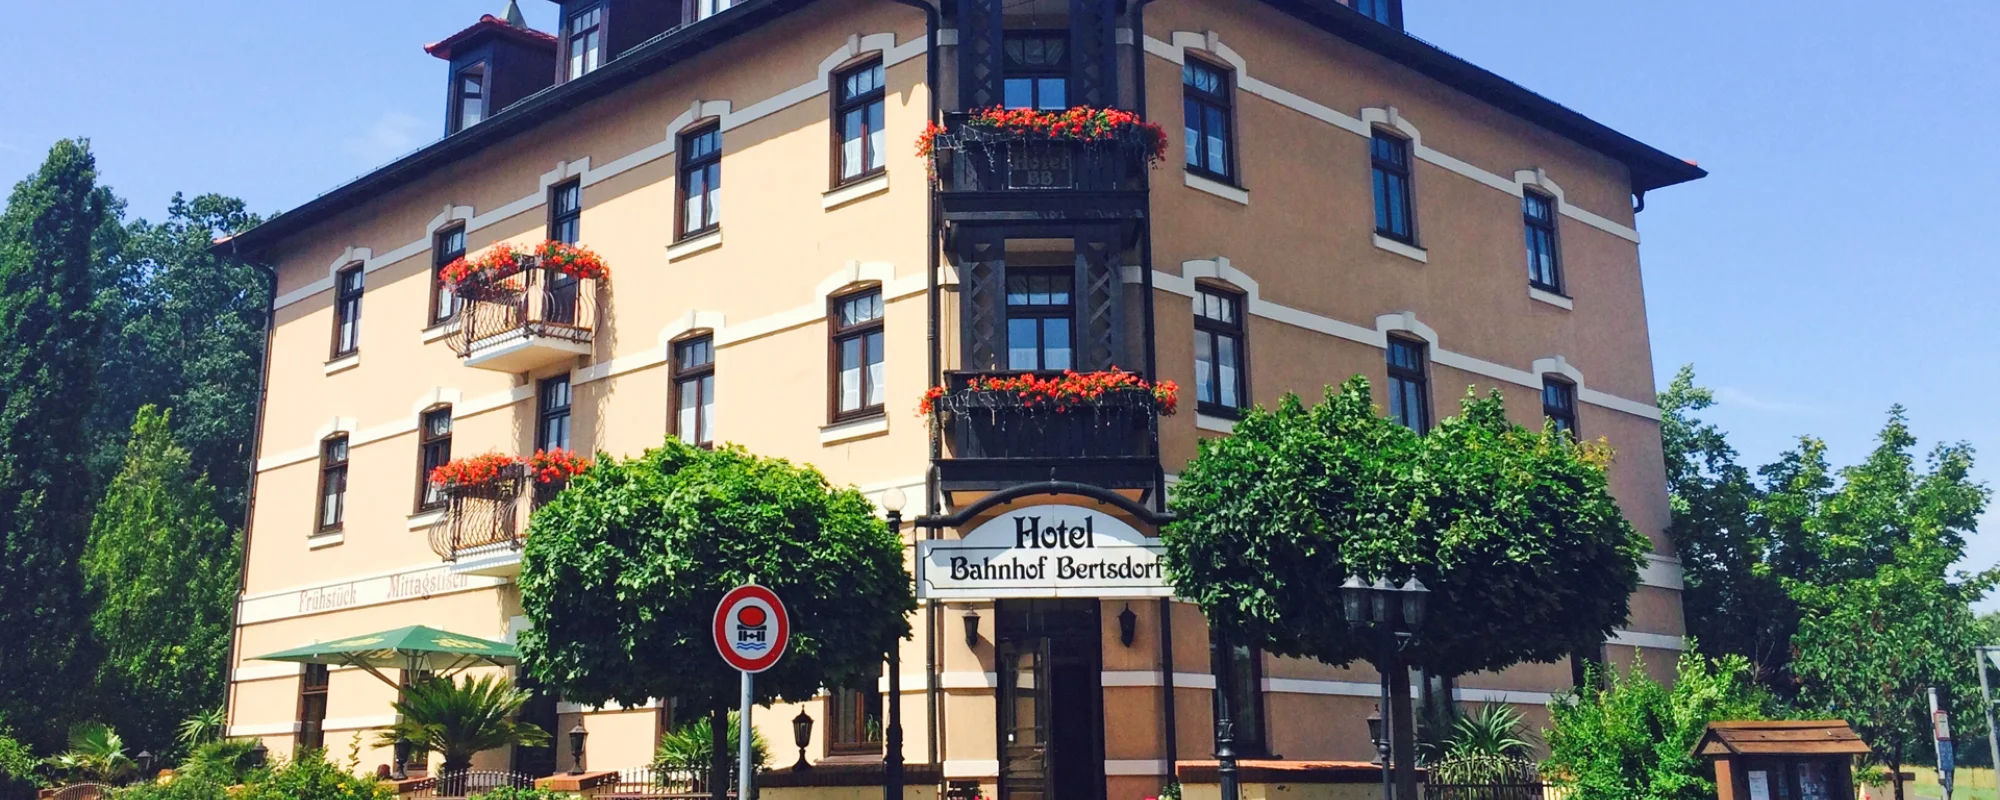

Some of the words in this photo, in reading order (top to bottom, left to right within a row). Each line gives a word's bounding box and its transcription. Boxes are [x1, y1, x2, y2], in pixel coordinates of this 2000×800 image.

[1027, 171, 1054, 186] BB
[1013, 515, 1094, 549] Hotel
[950, 556, 1047, 580] Bahnhof
[1056, 555, 1164, 580] Bertsdorf
[298, 581, 357, 612] Frühstück
[387, 571, 468, 598] Mittagstisch
